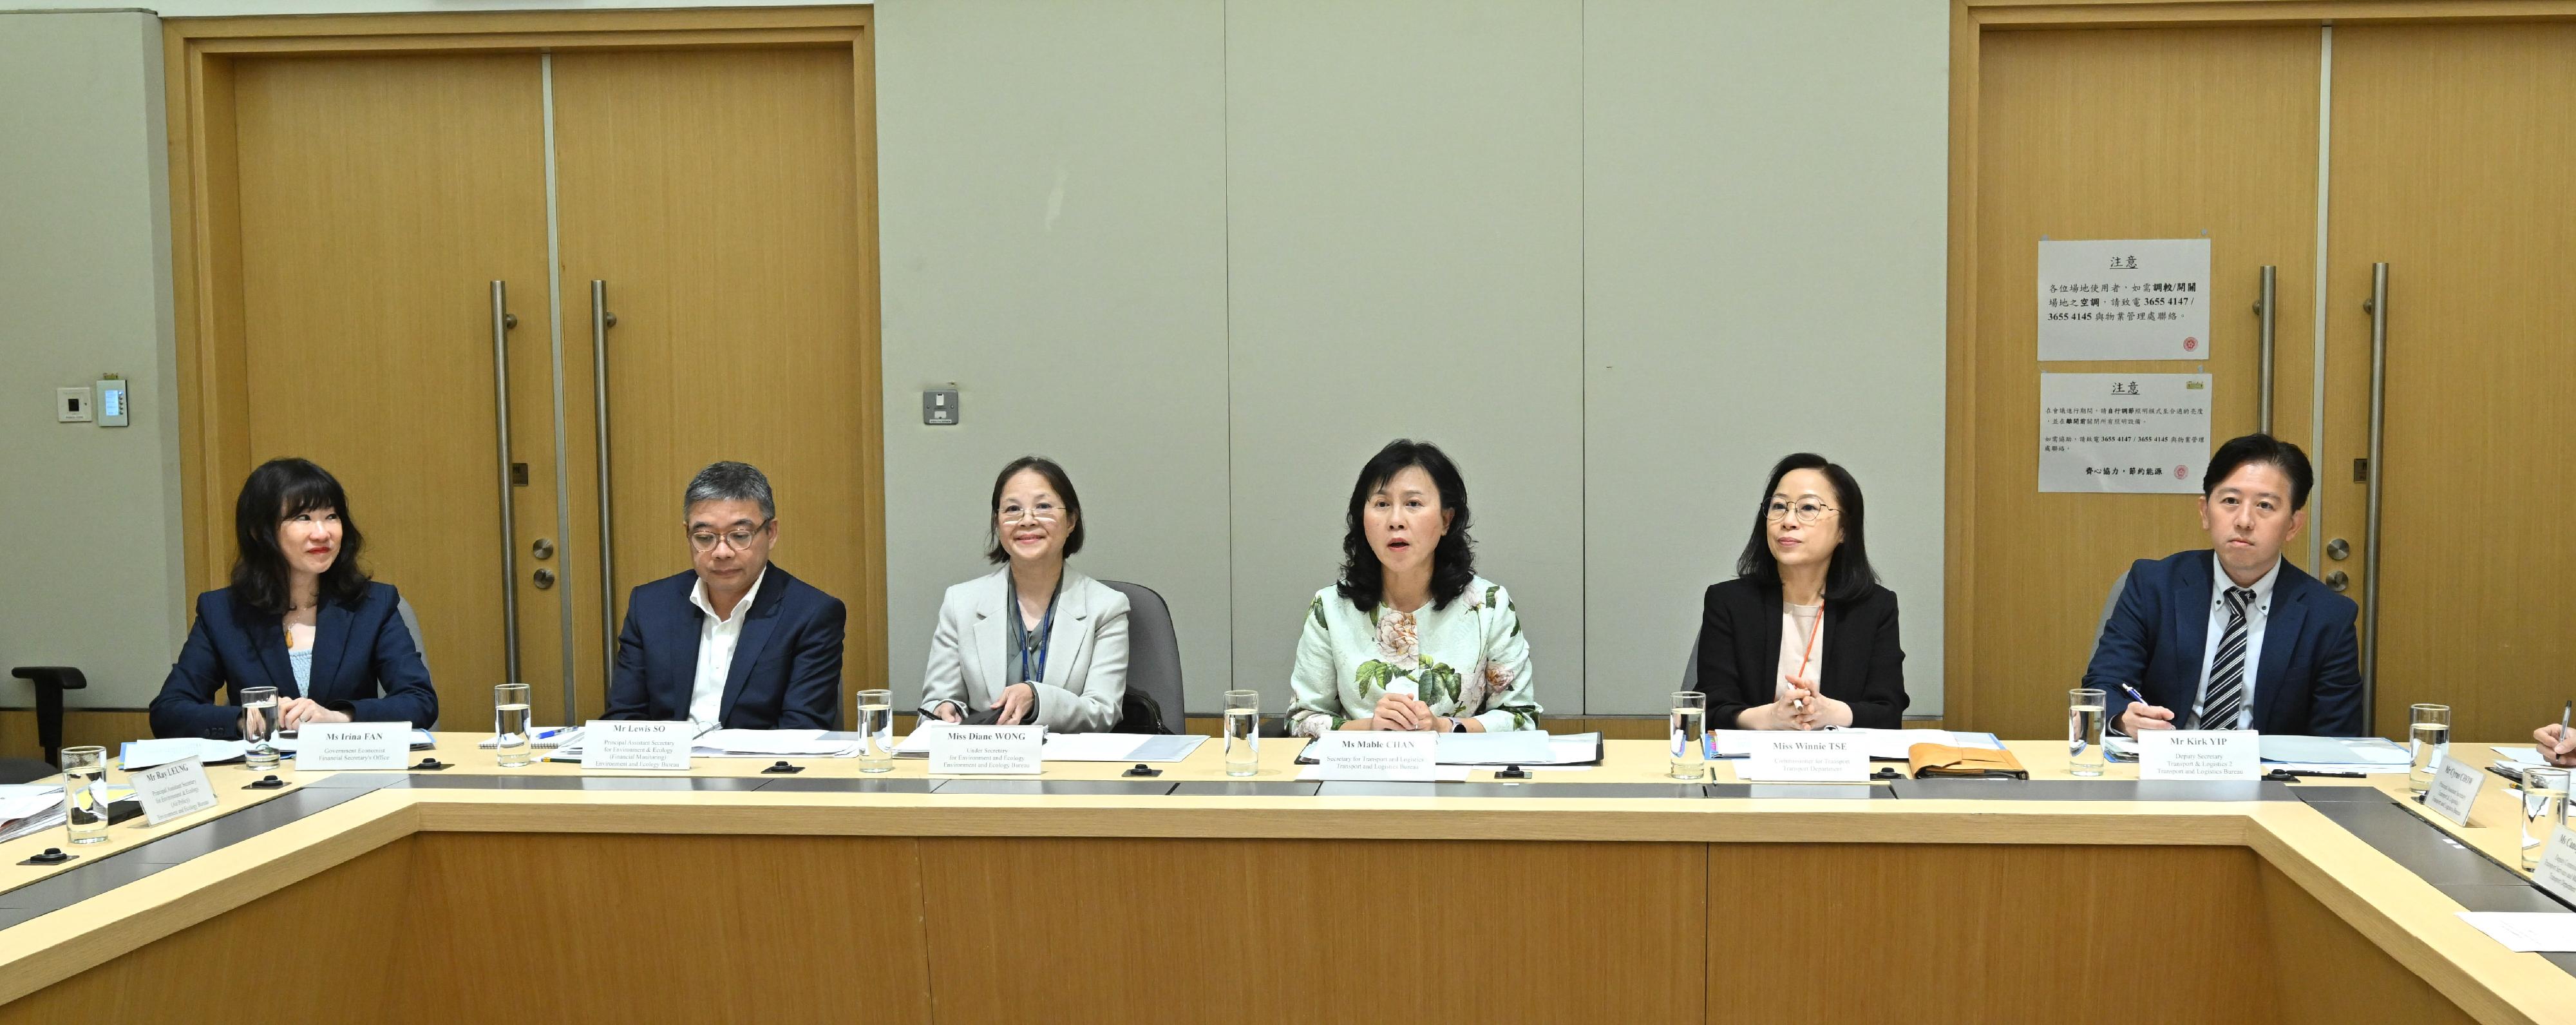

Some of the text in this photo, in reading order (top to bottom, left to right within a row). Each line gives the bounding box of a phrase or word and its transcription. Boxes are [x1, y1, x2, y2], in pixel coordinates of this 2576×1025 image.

[2110, 255, 2138, 268] 注意
[2049, 298, 2141, 307] 場地之空調，請致電
[2144, 297, 2164, 306] 3655
[2167, 297, 2188, 306] 4147
[2048, 312, 2186, 321] 3655 4145 與物業管理處聯絡。
[2112, 381, 2139, 394] 注意
[2086, 466, 2163, 475] 齊心協力，節約能源
[146, 773, 155, 781] Mr
[167, 763, 189, 776] LEUNG
